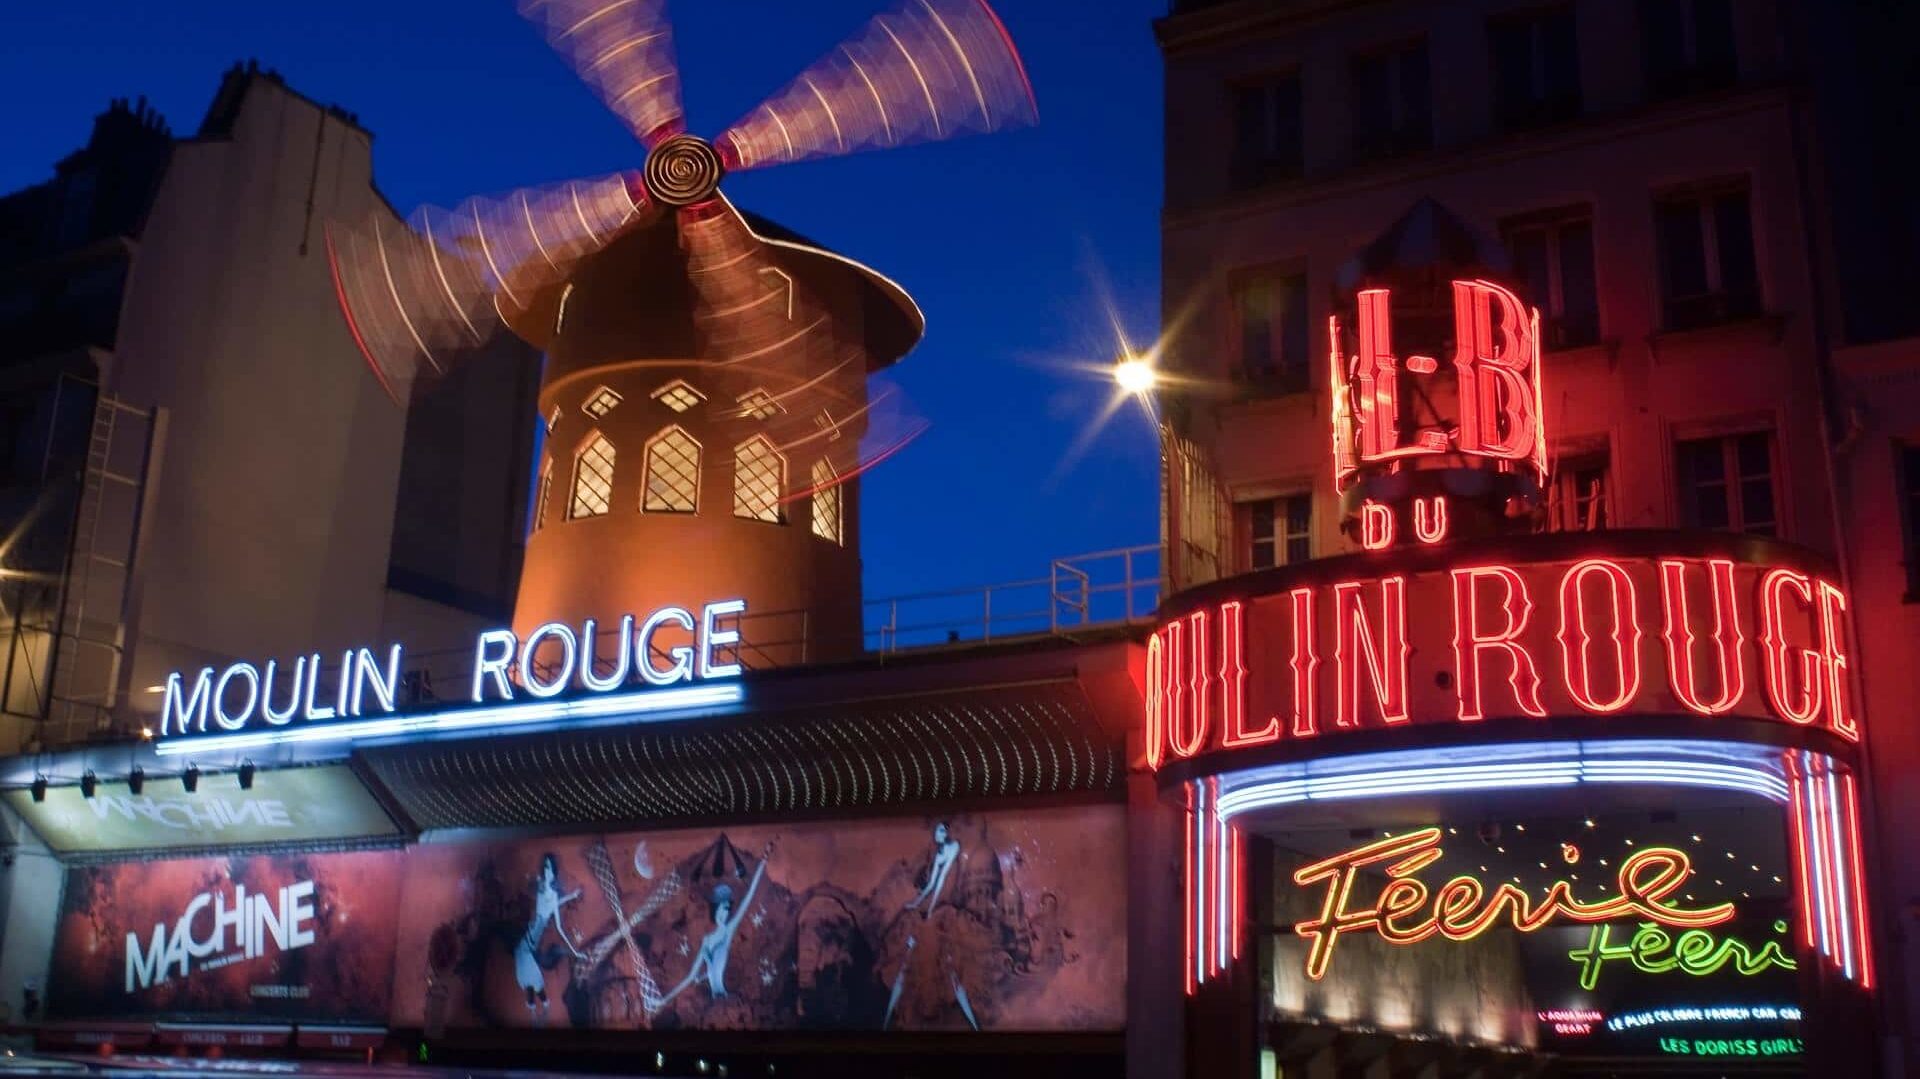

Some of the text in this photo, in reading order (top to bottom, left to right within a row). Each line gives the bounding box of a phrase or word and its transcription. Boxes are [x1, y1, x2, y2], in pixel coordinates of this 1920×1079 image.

[1362, 497, 1446, 549] DU
[160, 599, 746, 735] MOULIN ROUGE
[1146, 559, 1858, 771] OULIN ROUGE
[125, 879, 315, 994] MACHINE
[1294, 827, 1735, 981] Féerie
[1569, 912, 1797, 990] Féeri
[1607, 1017, 1624, 1031] LE
[1624, 1012, 1655, 1027] PLUS
[1660, 1037, 1691, 1053] LES
[1694, 1039, 1758, 1056] DORISS
